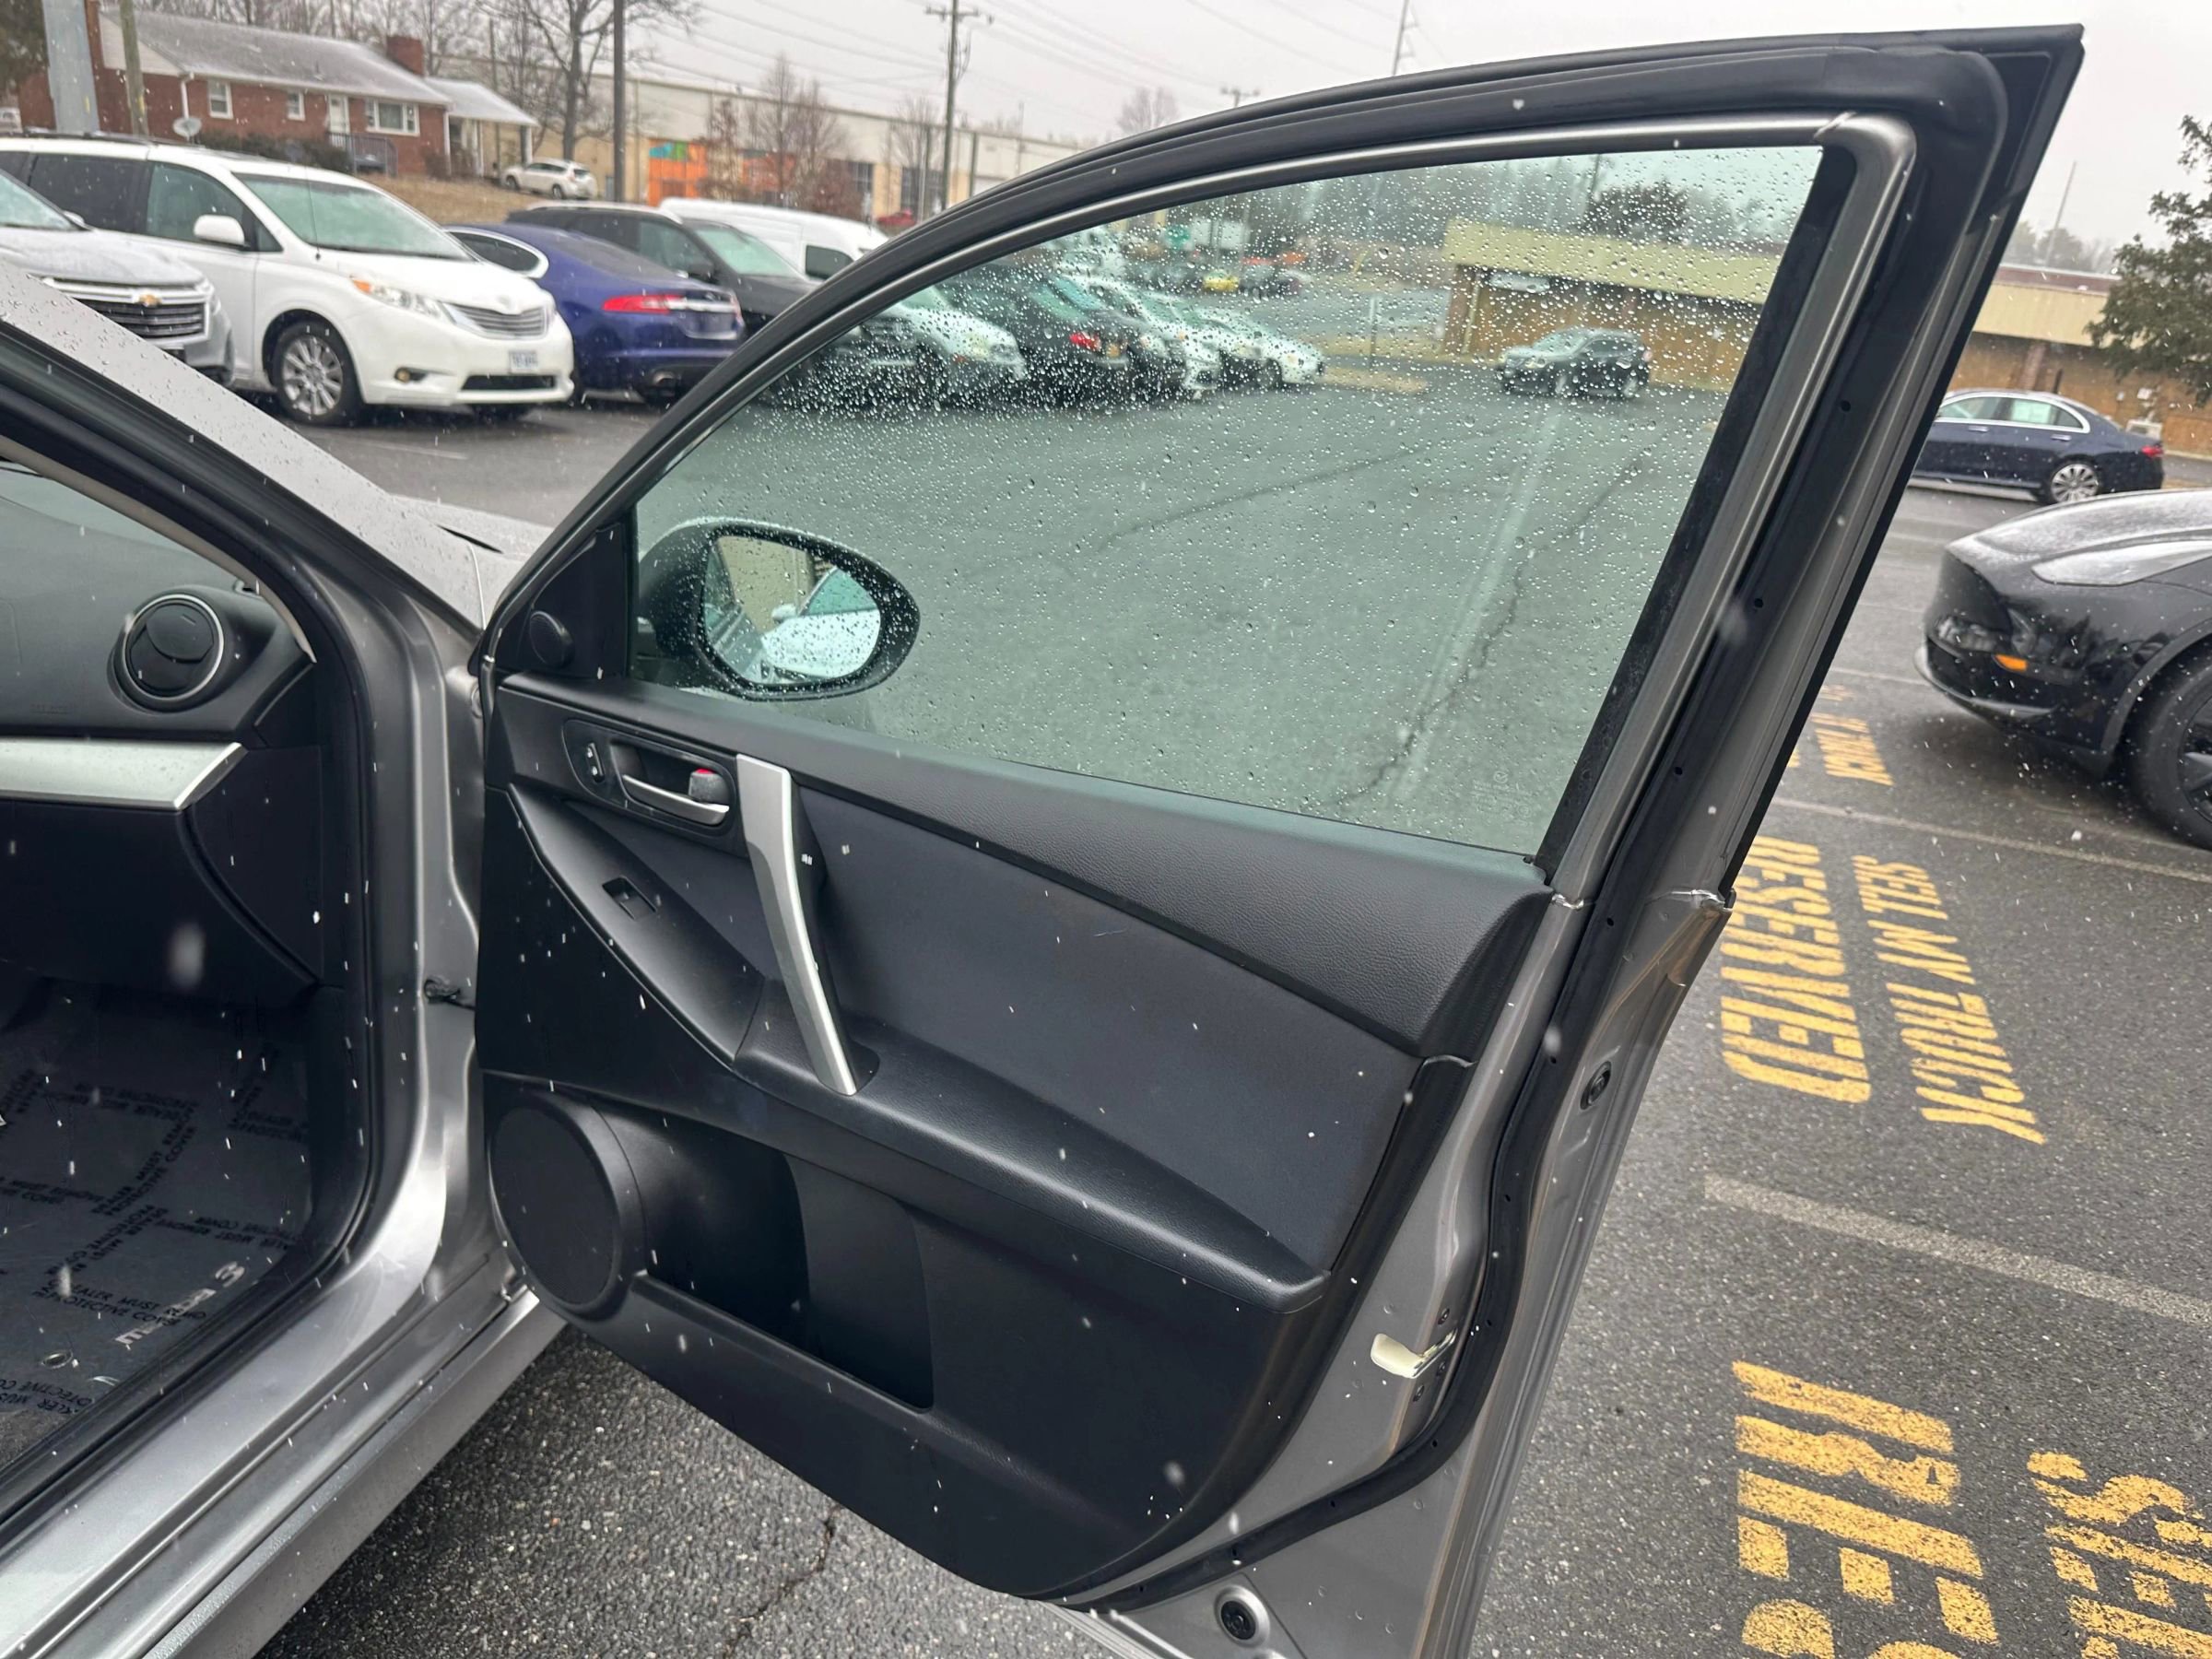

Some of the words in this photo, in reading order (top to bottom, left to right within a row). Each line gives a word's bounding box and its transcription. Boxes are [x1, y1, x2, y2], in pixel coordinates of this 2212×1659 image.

[1852, 854, 1948, 920] SELL
[1720, 835, 1872, 1103] RESERVED
[1867, 919, 1976, 984] MY
[1885, 981, 2047, 1145] TRUCK
[118, 1296, 160, 1312] MUST
